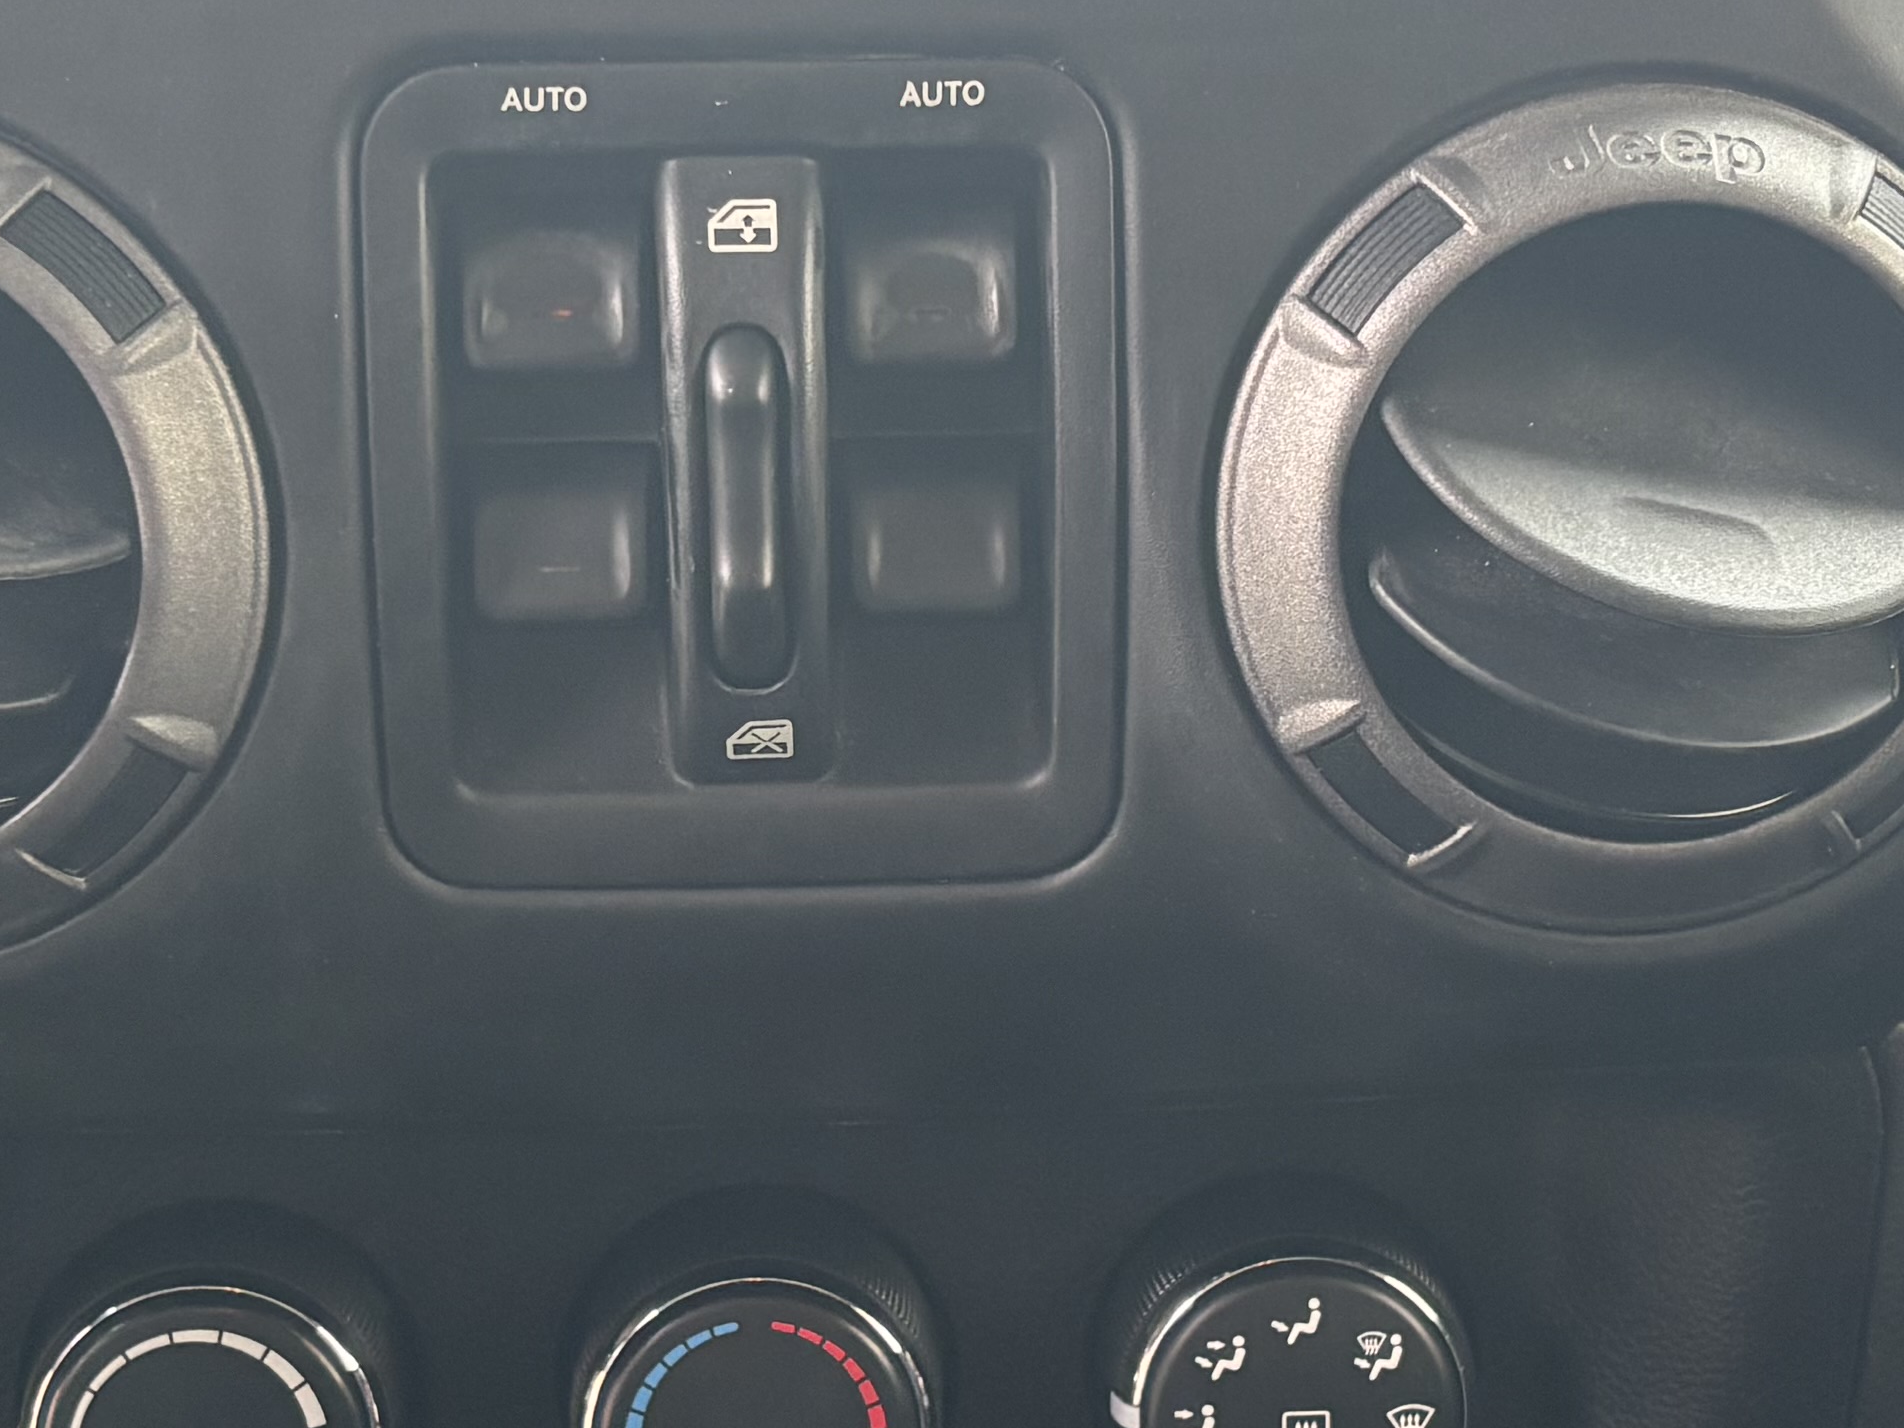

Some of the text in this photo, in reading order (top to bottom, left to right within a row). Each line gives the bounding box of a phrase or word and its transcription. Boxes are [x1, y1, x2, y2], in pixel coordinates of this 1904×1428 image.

[500, 86, 588, 113] AUTO
[899, 79, 985, 108] AUTO
[1548, 124, 1766, 185] Jeep
